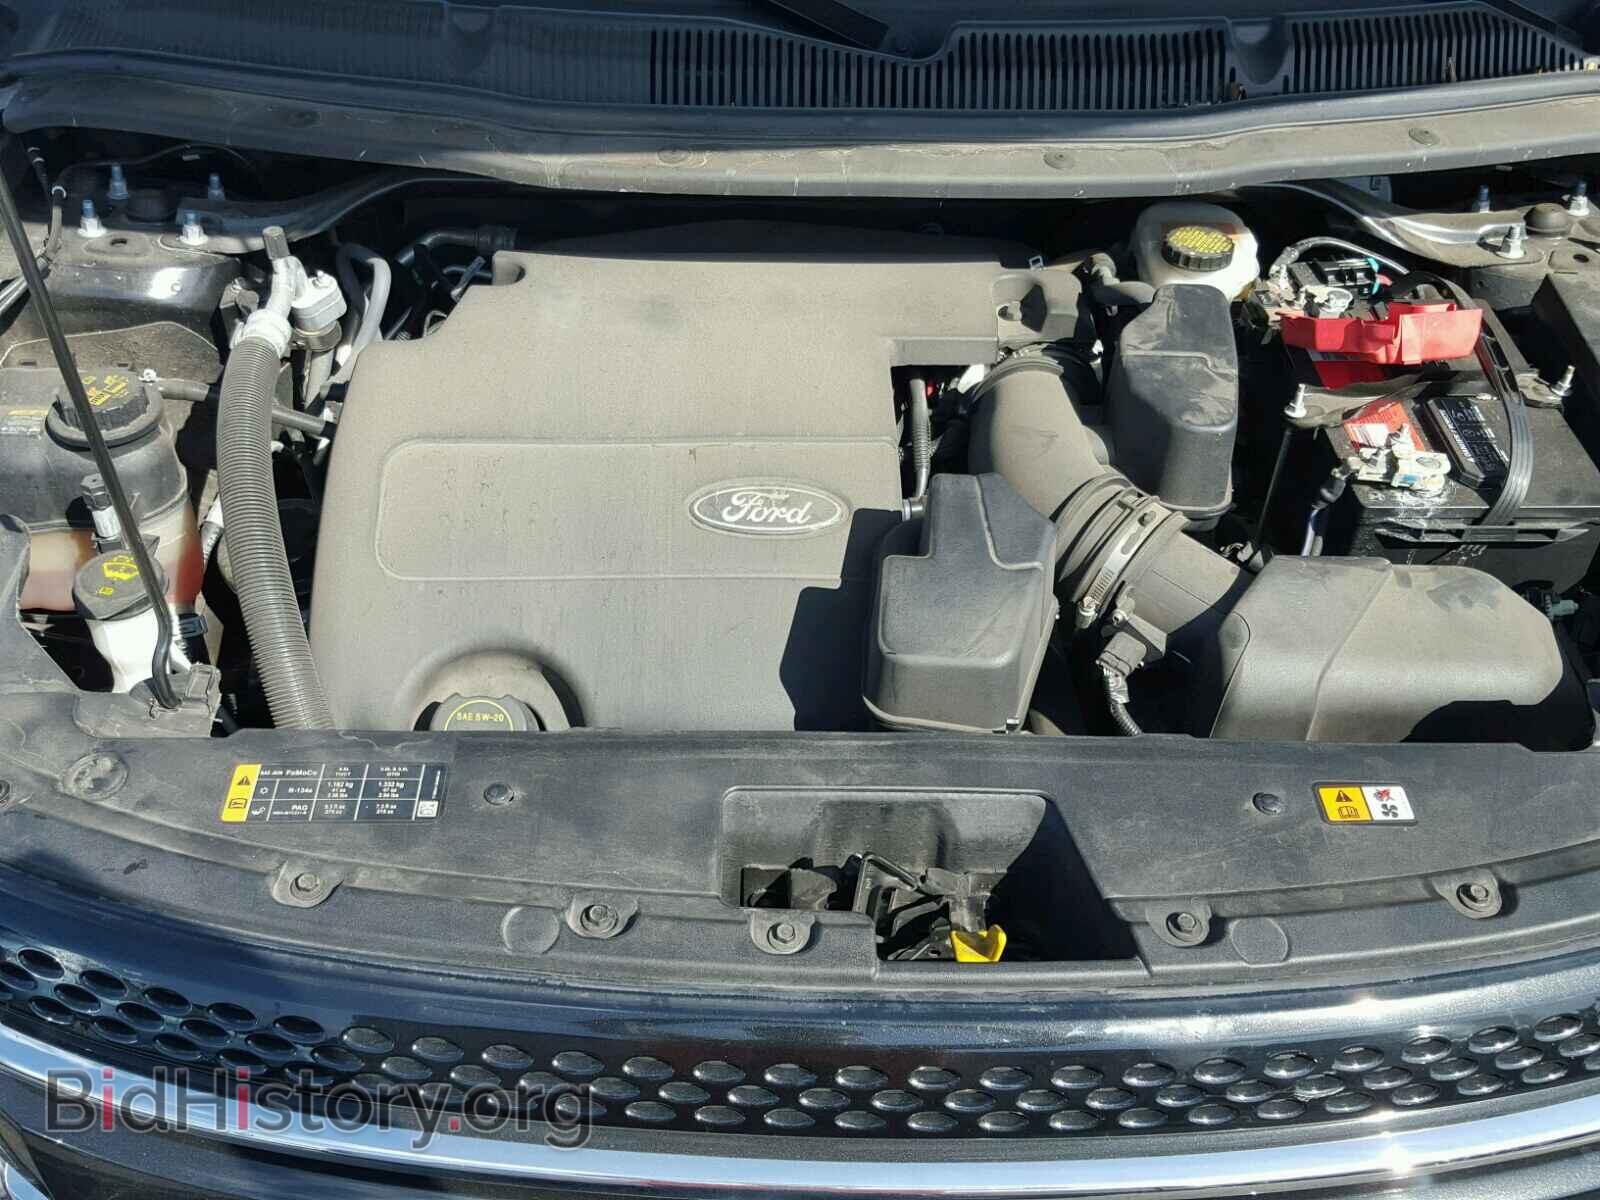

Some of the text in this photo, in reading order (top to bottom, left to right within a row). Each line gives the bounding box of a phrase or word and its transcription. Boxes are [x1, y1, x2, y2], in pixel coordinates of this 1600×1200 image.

[721, 490, 813, 525] Ford
[456, 711, 505, 722] SAE 5W-20
